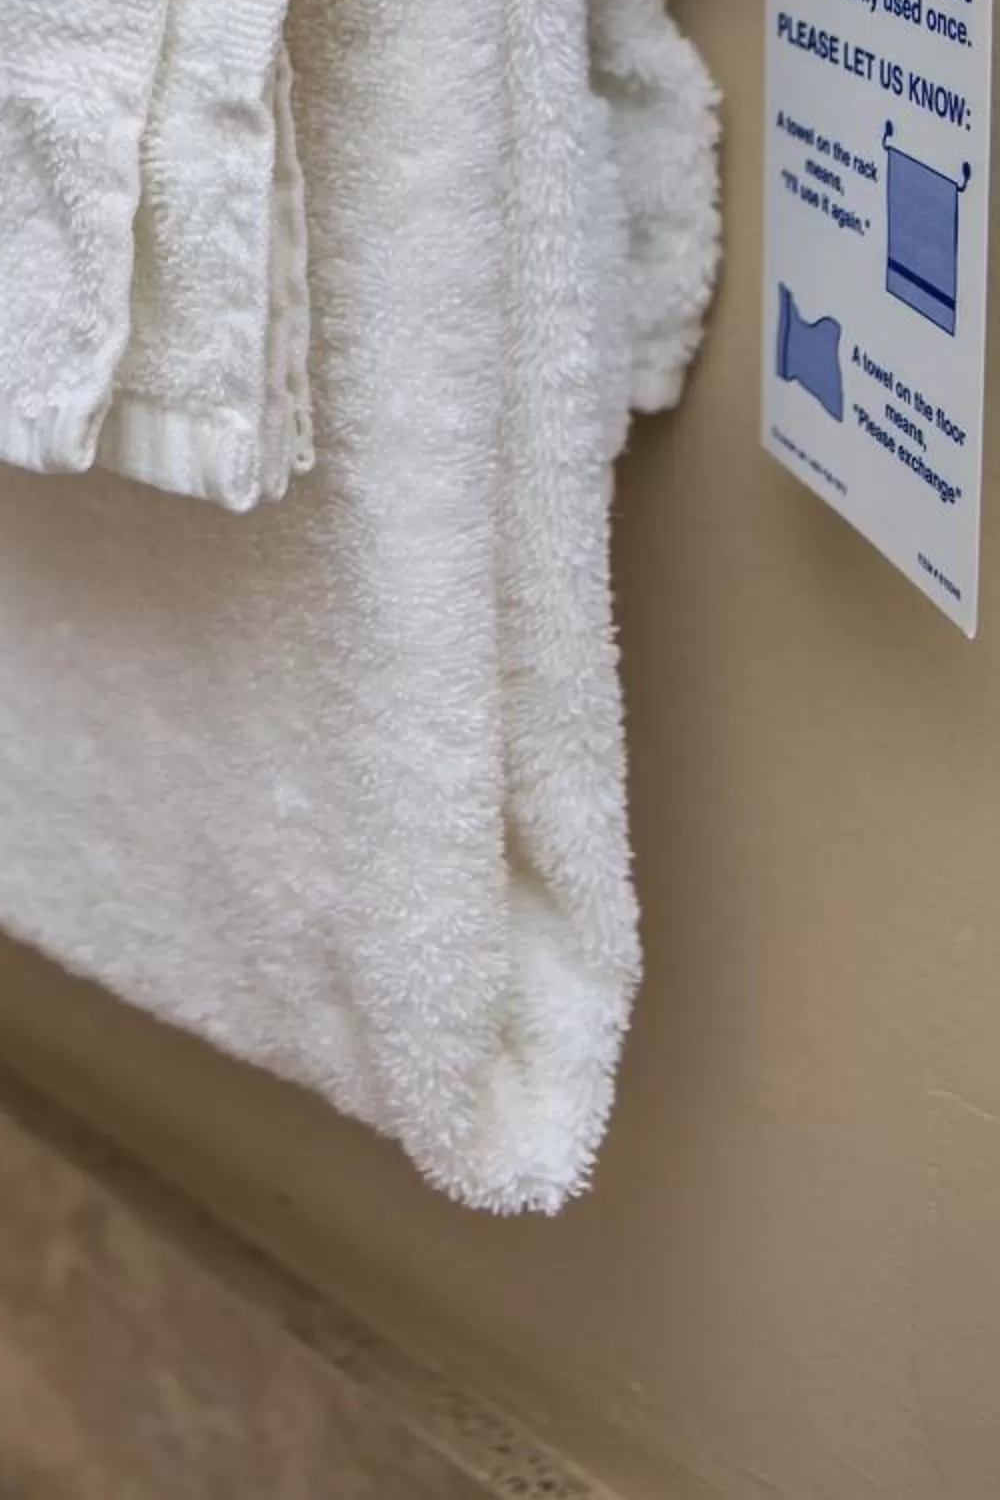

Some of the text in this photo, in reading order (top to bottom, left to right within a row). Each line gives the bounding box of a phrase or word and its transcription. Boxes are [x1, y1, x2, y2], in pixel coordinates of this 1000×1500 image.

[926, 7, 972, 47] once.
[777, 12, 971, 132] PLEASE LET US KNOW:
[786, 116, 814, 145] towel
[833, 141, 850, 167] the
[800, 184, 819, 208] use
[863, 352, 893, 391] towel
[914, 392, 933, 422] the
[936, 408, 966, 446] floor
[885, 404, 927, 452] means,
